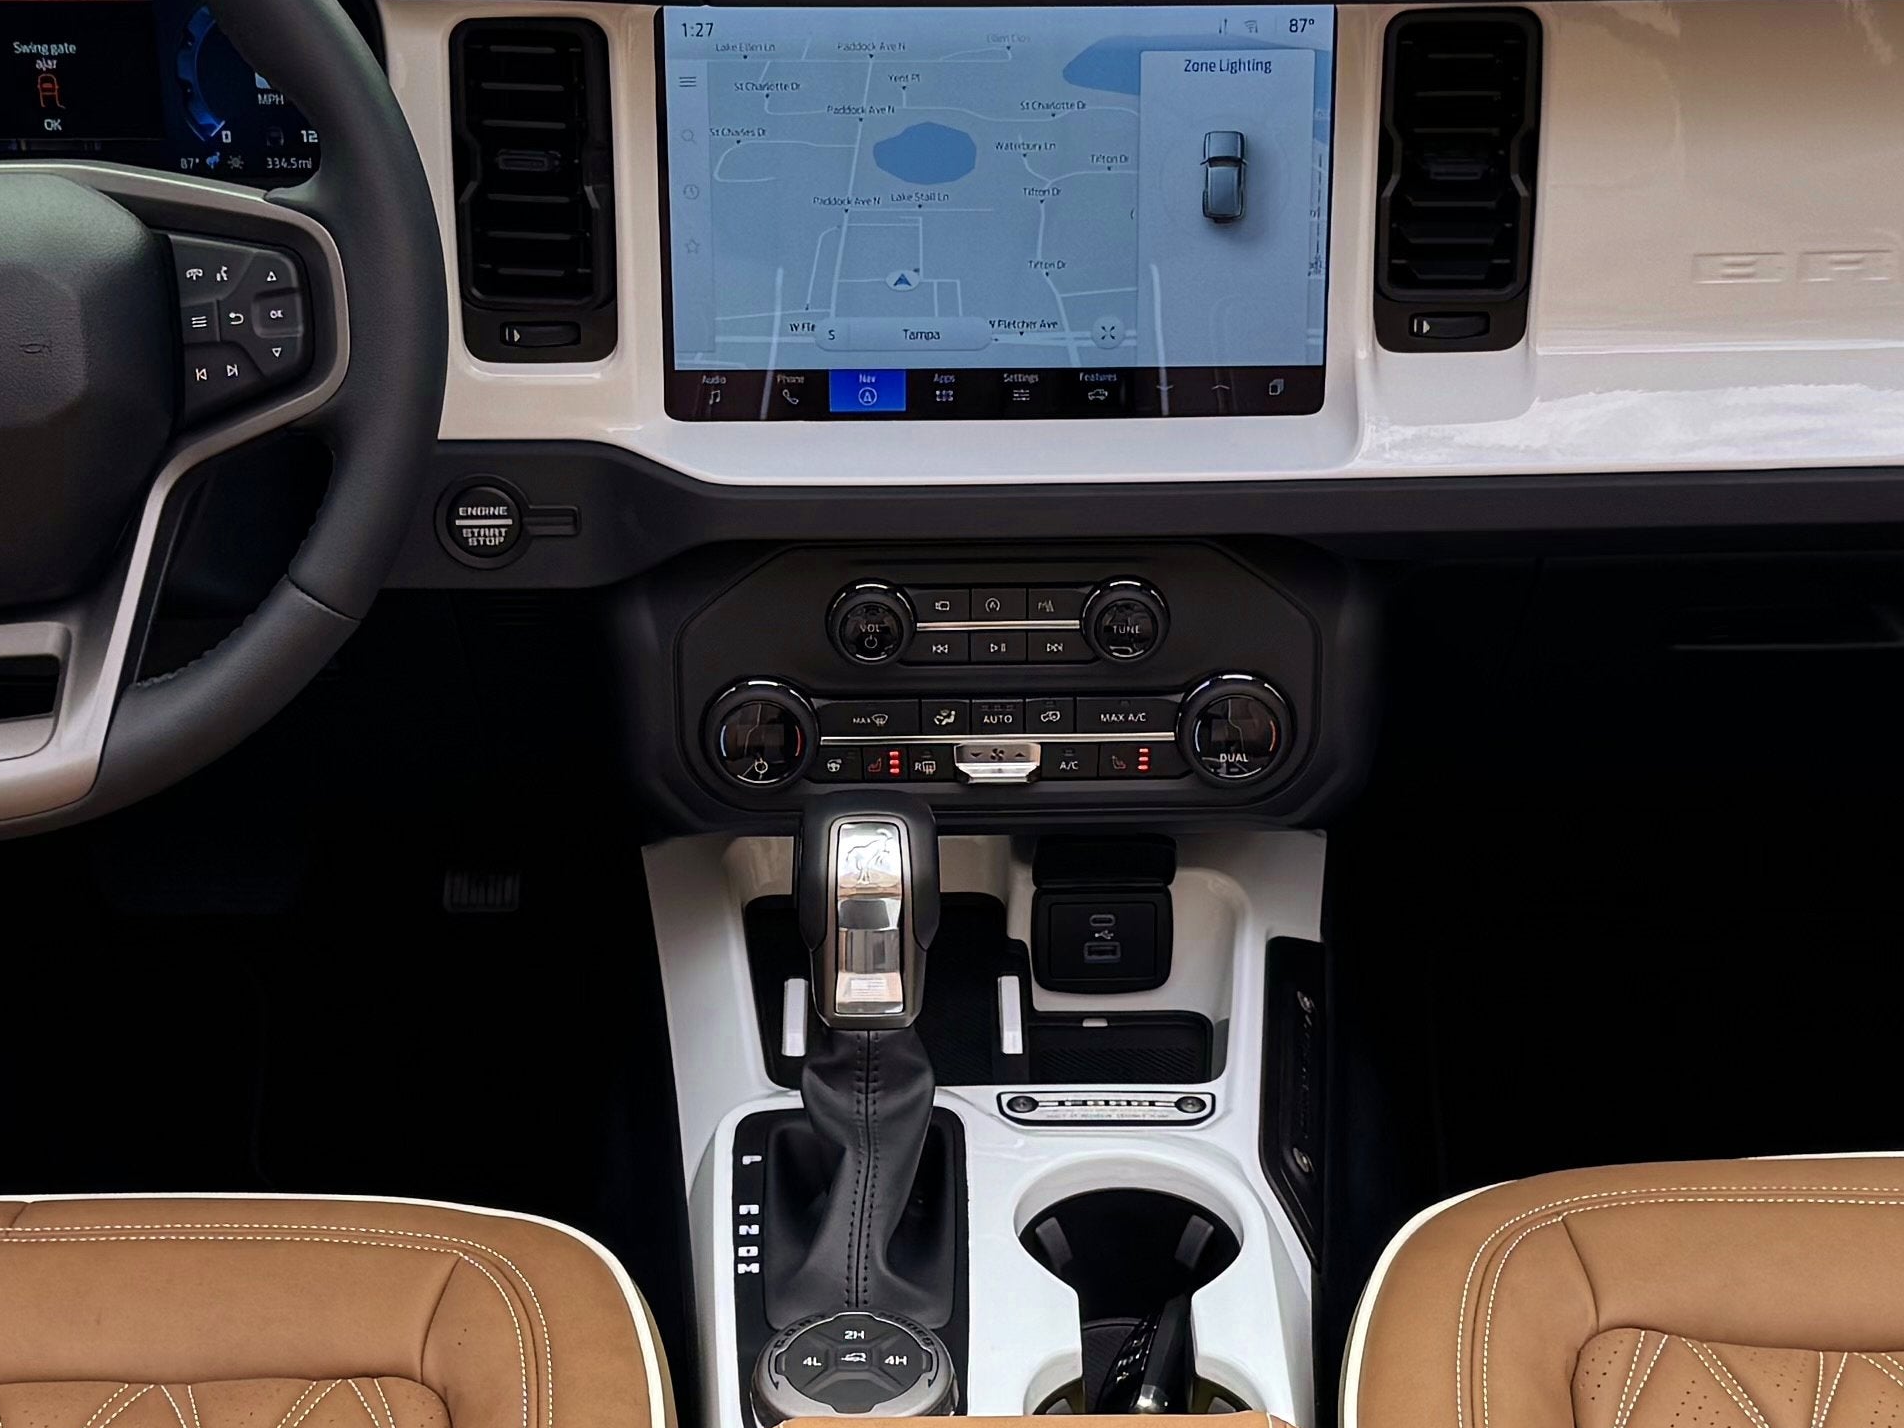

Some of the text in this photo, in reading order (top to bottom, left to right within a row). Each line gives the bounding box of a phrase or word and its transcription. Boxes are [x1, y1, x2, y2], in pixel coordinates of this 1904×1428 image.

[681, 22, 714, 38] 1:27
[1289, 18, 1315, 33] 87°
[13, 42, 77, 57] Swing gate
[35, 58, 57, 71] ajar
[1184, 58, 1272, 75] Zone Lighting
[257, 94, 284, 105] MPH
[826, 105, 867, 115] Paddock
[44, 119, 62, 131] OK
[222, 130, 231, 143] 0
[266, 157, 296, 169] 334.5
[890, 192, 912, 202] Lake
[269, 309, 284, 319] OK
[1038, 320, 1059, 329] Ave
[828, 330, 836, 340] S
[903, 329, 941, 342] Tampa
[702, 374, 727, 384] Audio
[777, 374, 805, 384] Phone
[859, 374, 876, 384] Nav
[933, 374, 956, 385] Apps
[1003, 372, 1039, 385] Settings
[1079, 372, 1118, 383] Features
[459, 506, 508, 516] ENGINE
[462, 527, 508, 538] START
[468, 536, 504, 546] STOP
[859, 624, 881, 633] VOL
[1113, 625, 1141, 635] TUNE
[982, 714, 1013, 724] AUTO
[1100, 712, 1146, 723] MAX A/C
[1219, 752, 1248, 763] DUAL
[1059, 759, 1079, 771] A/C
[737, 1263, 760, 1274] M
[844, 1330, 865, 1340] 2H
[802, 1356, 822, 1366] 4L
[884, 1355, 907, 1366] 4H
